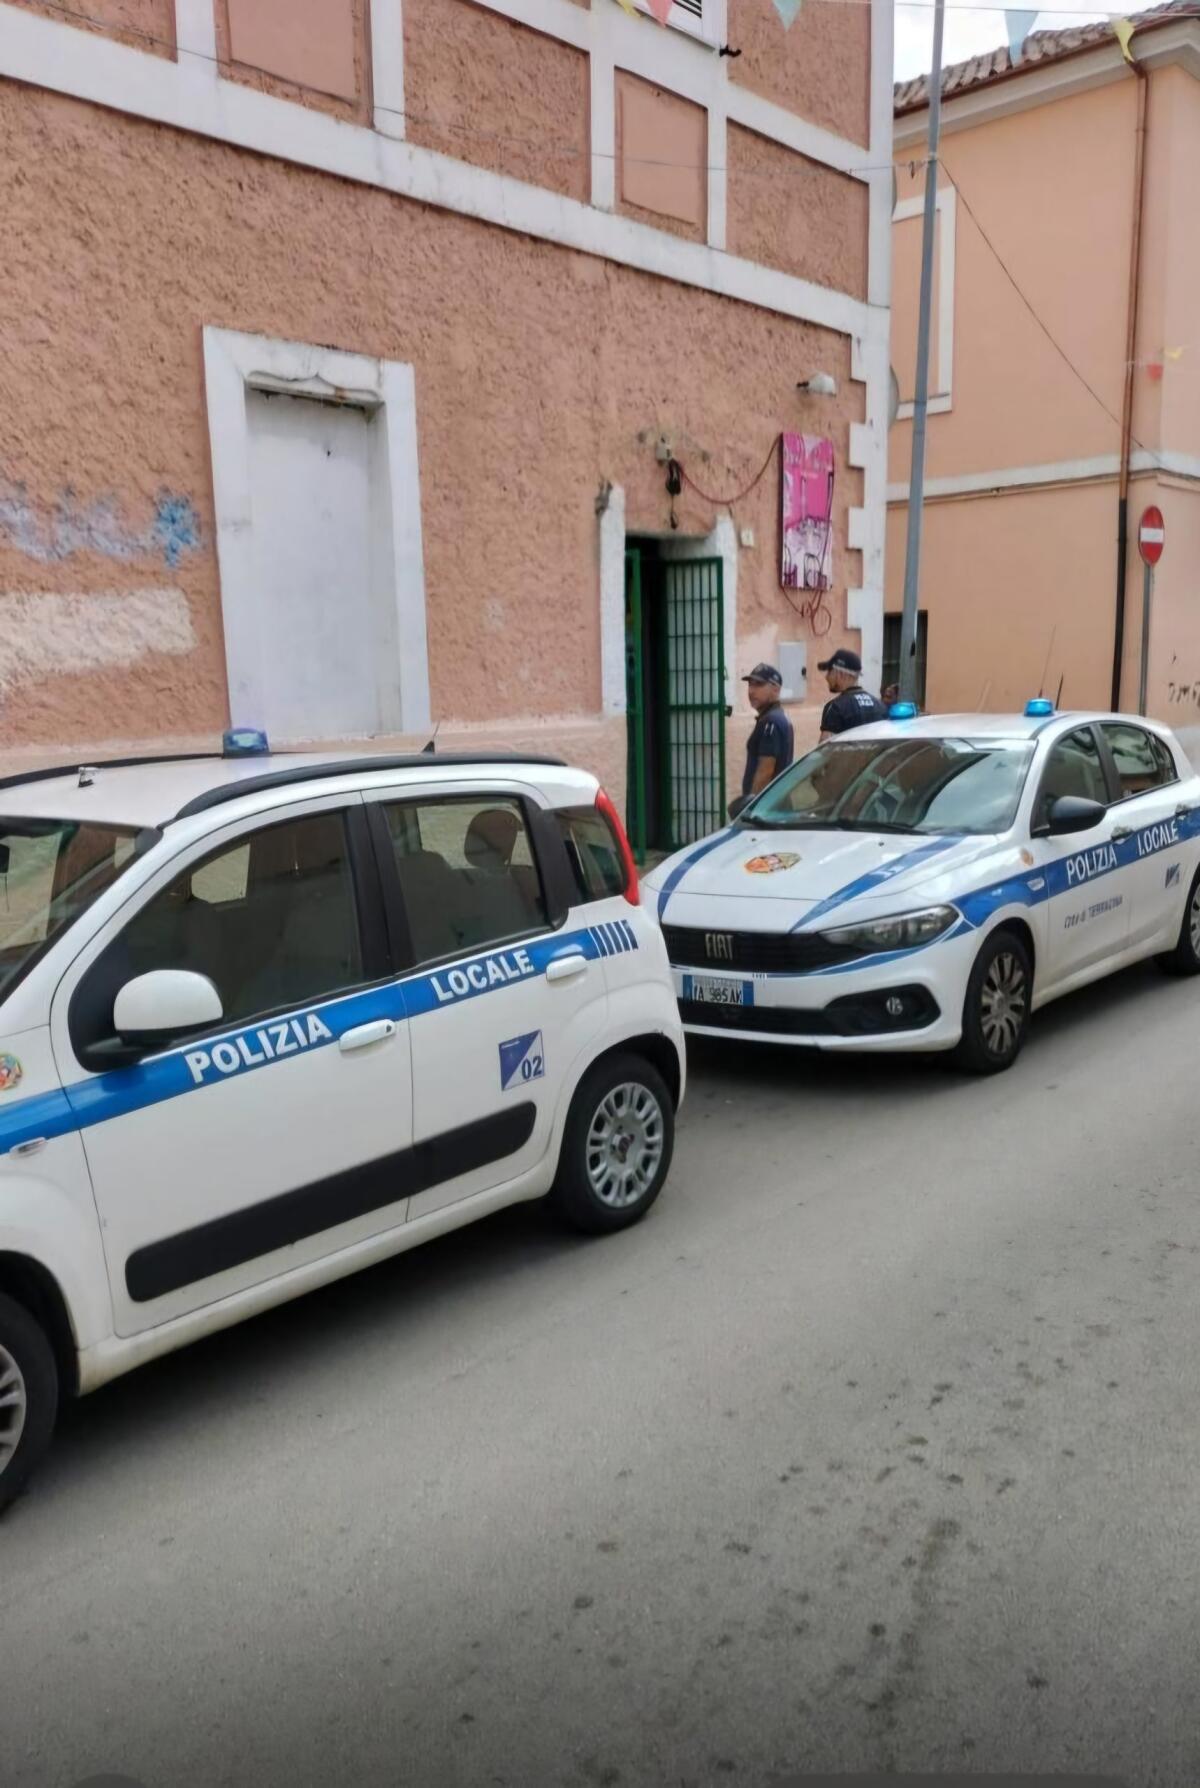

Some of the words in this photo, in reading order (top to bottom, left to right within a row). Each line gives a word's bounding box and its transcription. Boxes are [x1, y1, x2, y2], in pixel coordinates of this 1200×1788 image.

[1066, 843, 1118, 885] POLIZIA
[1137, 820, 1179, 856] LOCALE
[705, 933, 733, 960] FIAT
[184, 1013, 333, 1084] POLIZIA
[429, 949, 535, 1002] LOCALE
[521, 1055, 543, 1080] 02
